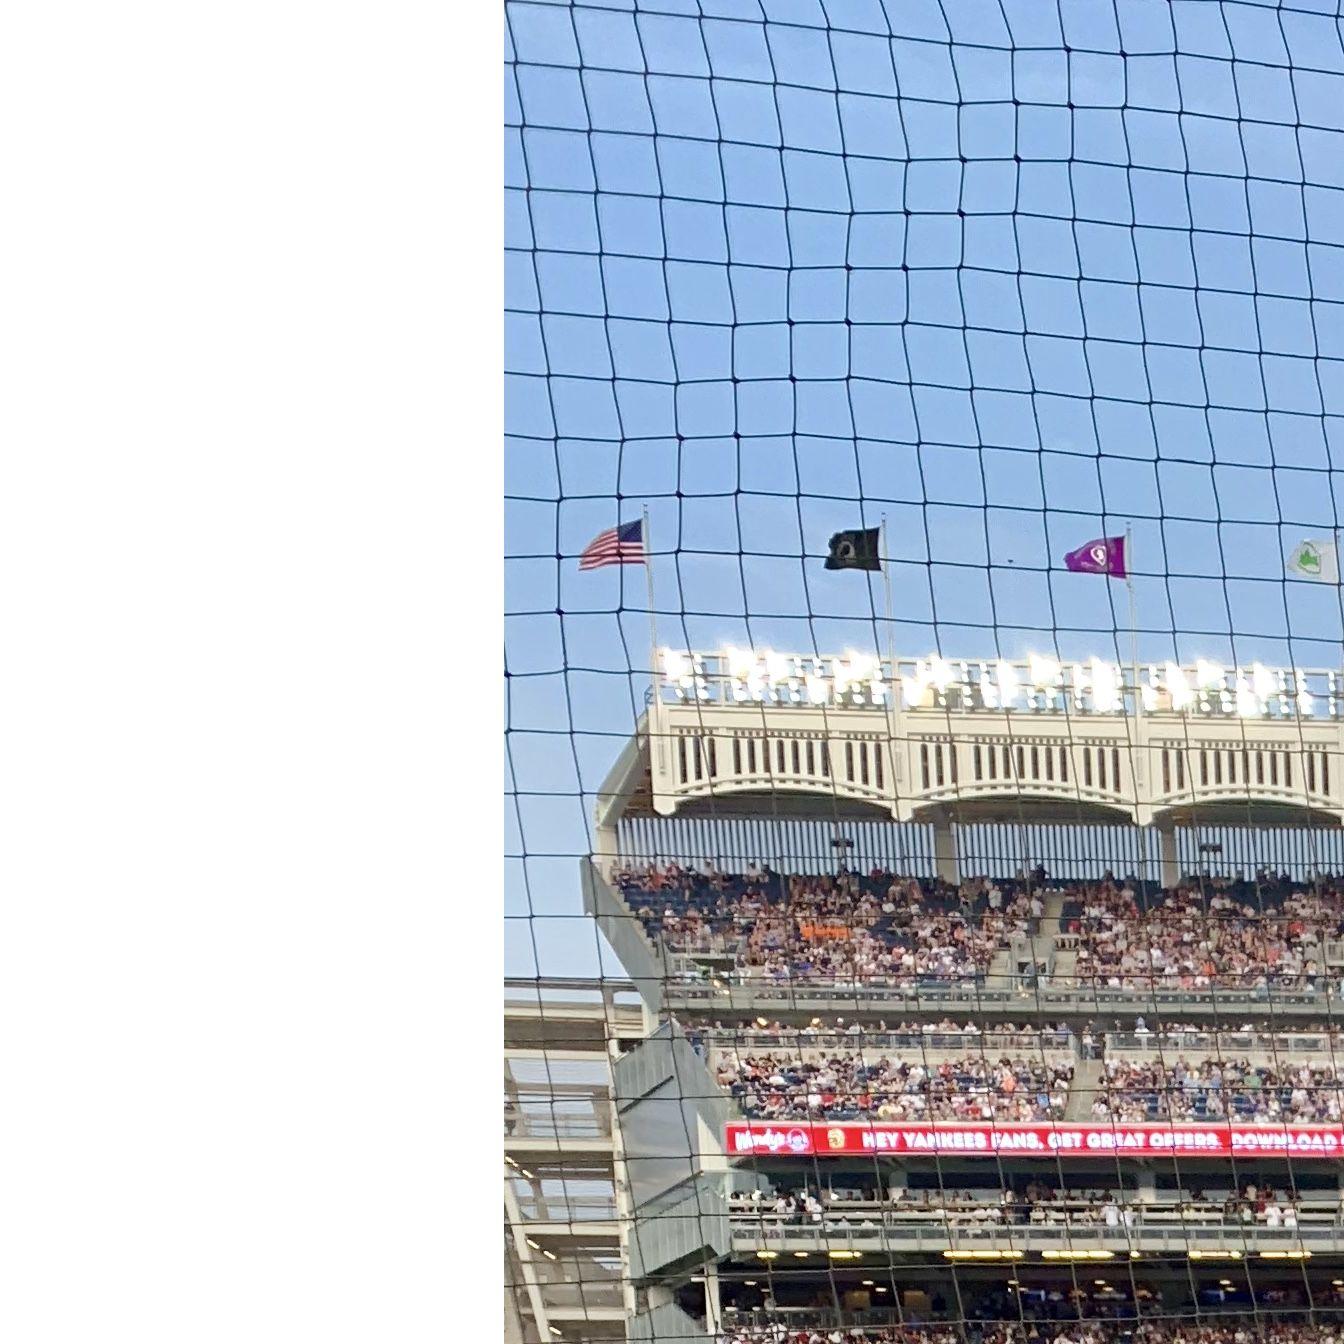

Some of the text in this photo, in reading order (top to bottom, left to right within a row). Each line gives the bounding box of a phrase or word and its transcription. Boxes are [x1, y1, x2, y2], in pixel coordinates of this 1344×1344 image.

[862, 1131, 899, 1149] HEY
[903, 1131, 986, 1149] YANKEES
[1047, 1131, 1083, 1149] GET
[1086, 1131, 1146, 1149] GREAT
[1230, 1131, 1338, 1151] DOWNLOAD
